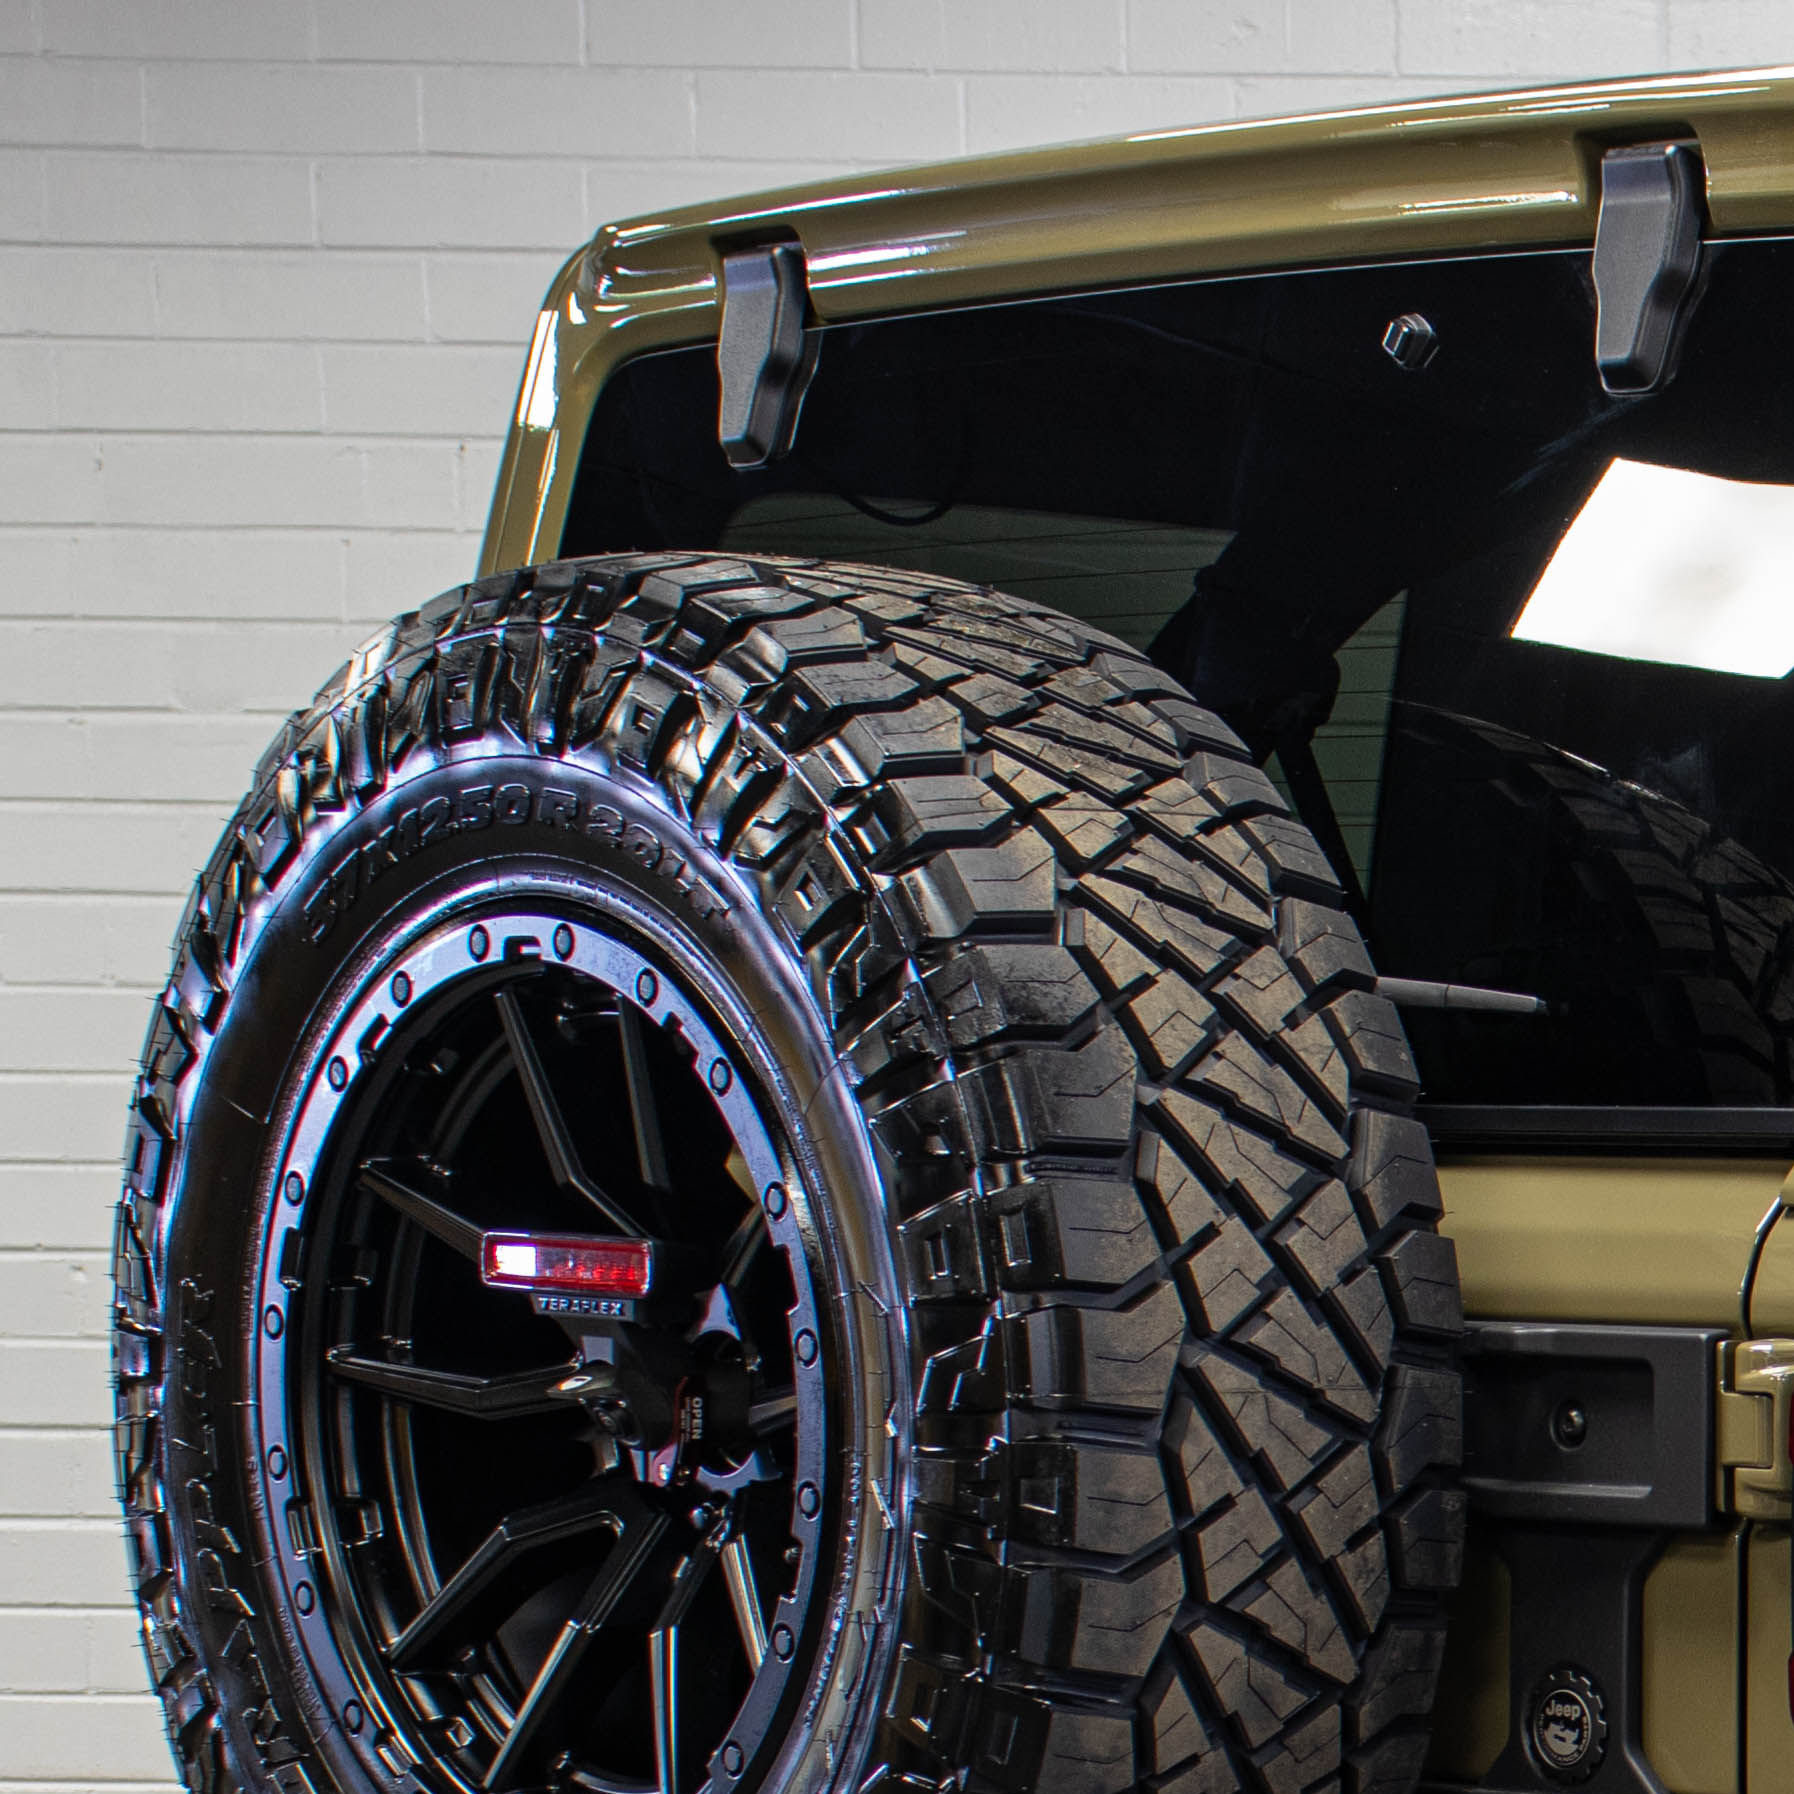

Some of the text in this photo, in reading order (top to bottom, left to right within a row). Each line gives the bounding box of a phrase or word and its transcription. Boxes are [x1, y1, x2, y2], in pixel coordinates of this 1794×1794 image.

[538, 1296, 624, 1317] TERAFLEX
[691, 1396, 703, 1440] OPEN
[1545, 1699, 1582, 1721] Jeep
